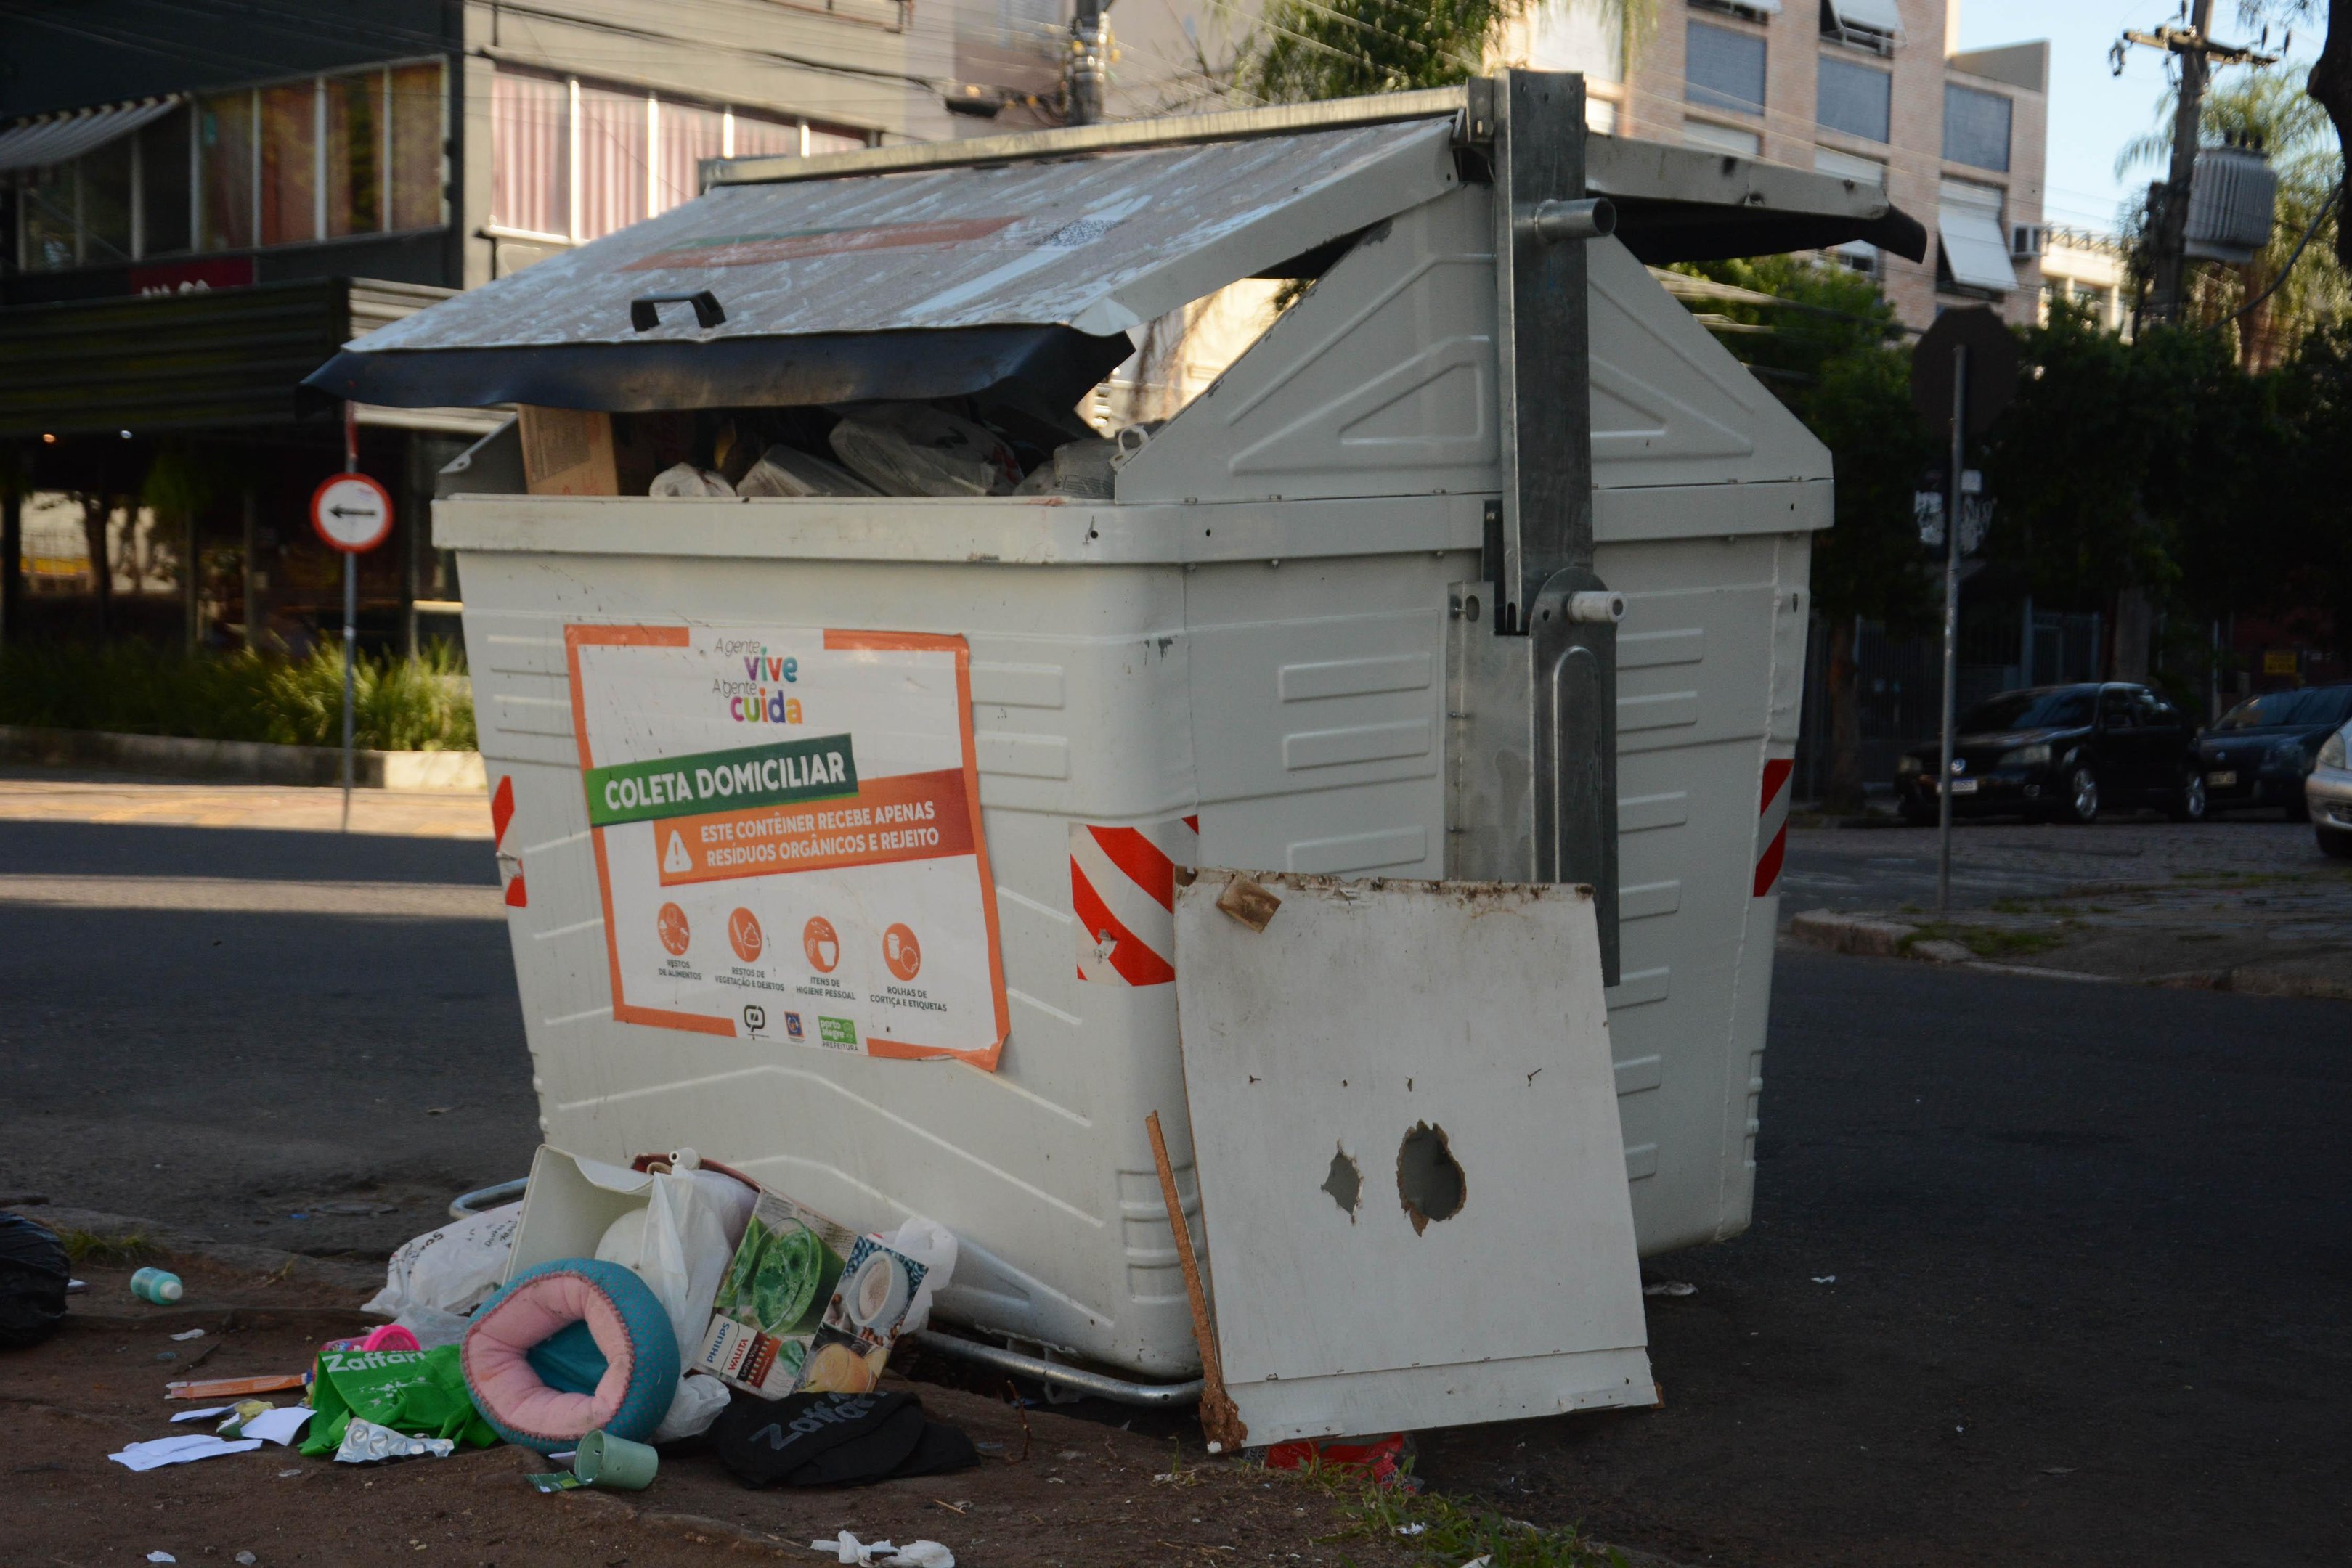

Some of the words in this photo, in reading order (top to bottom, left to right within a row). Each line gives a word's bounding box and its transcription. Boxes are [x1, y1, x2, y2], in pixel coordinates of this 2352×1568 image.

[725, 640, 760, 657] gente
[744, 646, 798, 683] vive
[723, 680, 757, 698] gente
[731, 687, 802, 724] cuida
[604, 771, 693, 810] COLETA
[695, 751, 846, 799] DOMICILIAR
[701, 822, 733, 843] ESTE
[736, 812, 815, 838] CONTÊINER
[818, 807, 871, 830] RECEBE
[874, 801, 935, 825] APENAS
[707, 842, 776, 867] RESÍDUOS
[779, 834, 866, 860] ORGÂNICOS
[869, 833, 878, 850] E
[881, 827, 939, 850] REJEITO
[667, 959, 690, 969] RESTOS
[668, 970, 702, 981] ALIMENTOS
[731, 967, 755, 978] RESTOS
[756, 970, 765, 979] DE
[810, 976, 830, 987] ITENS
[831, 979, 840, 987] DE
[715, 975, 751, 988] VEGETAÇÃO
[757, 980, 785, 992] DEJETOS
[887, 986, 916, 997] ROLHAS
[917, 989, 927, 998] DE
[796, 985, 823, 996] HIGIENE
[825, 989, 856, 1000] PESSOAL
[870, 995, 901, 1008] CORTIÇA
[908, 999, 947, 1012] ETIQUETAS
[822, 1040, 858, 1051] PREFEITURA
[707, 1322, 730, 1363] PHILIPS
[728, 1339, 749, 1371] WALITA
